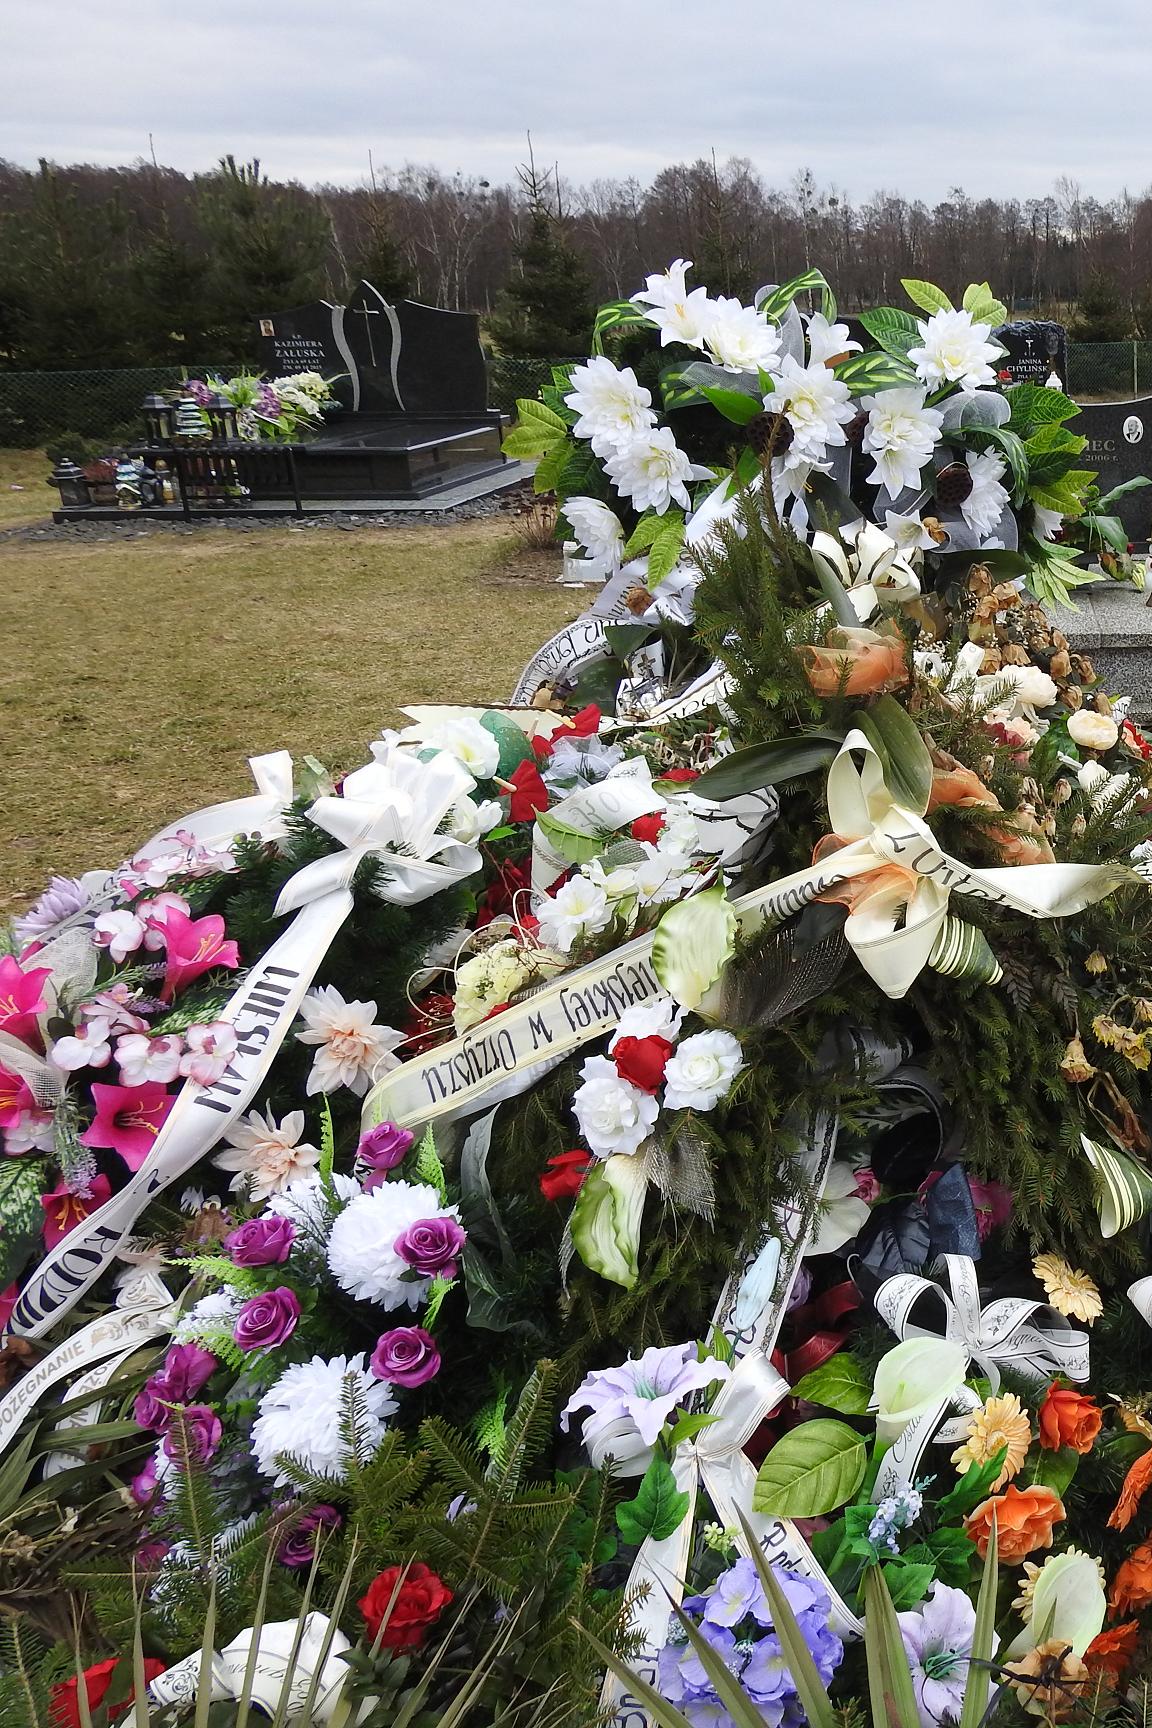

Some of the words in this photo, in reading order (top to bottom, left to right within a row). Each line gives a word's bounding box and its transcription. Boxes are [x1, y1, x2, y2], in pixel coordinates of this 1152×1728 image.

[528, 1011, 553, 1050] w
[559, 956, 664, 1039] iejskiej
[421, 1029, 517, 1104] Orzyszu
